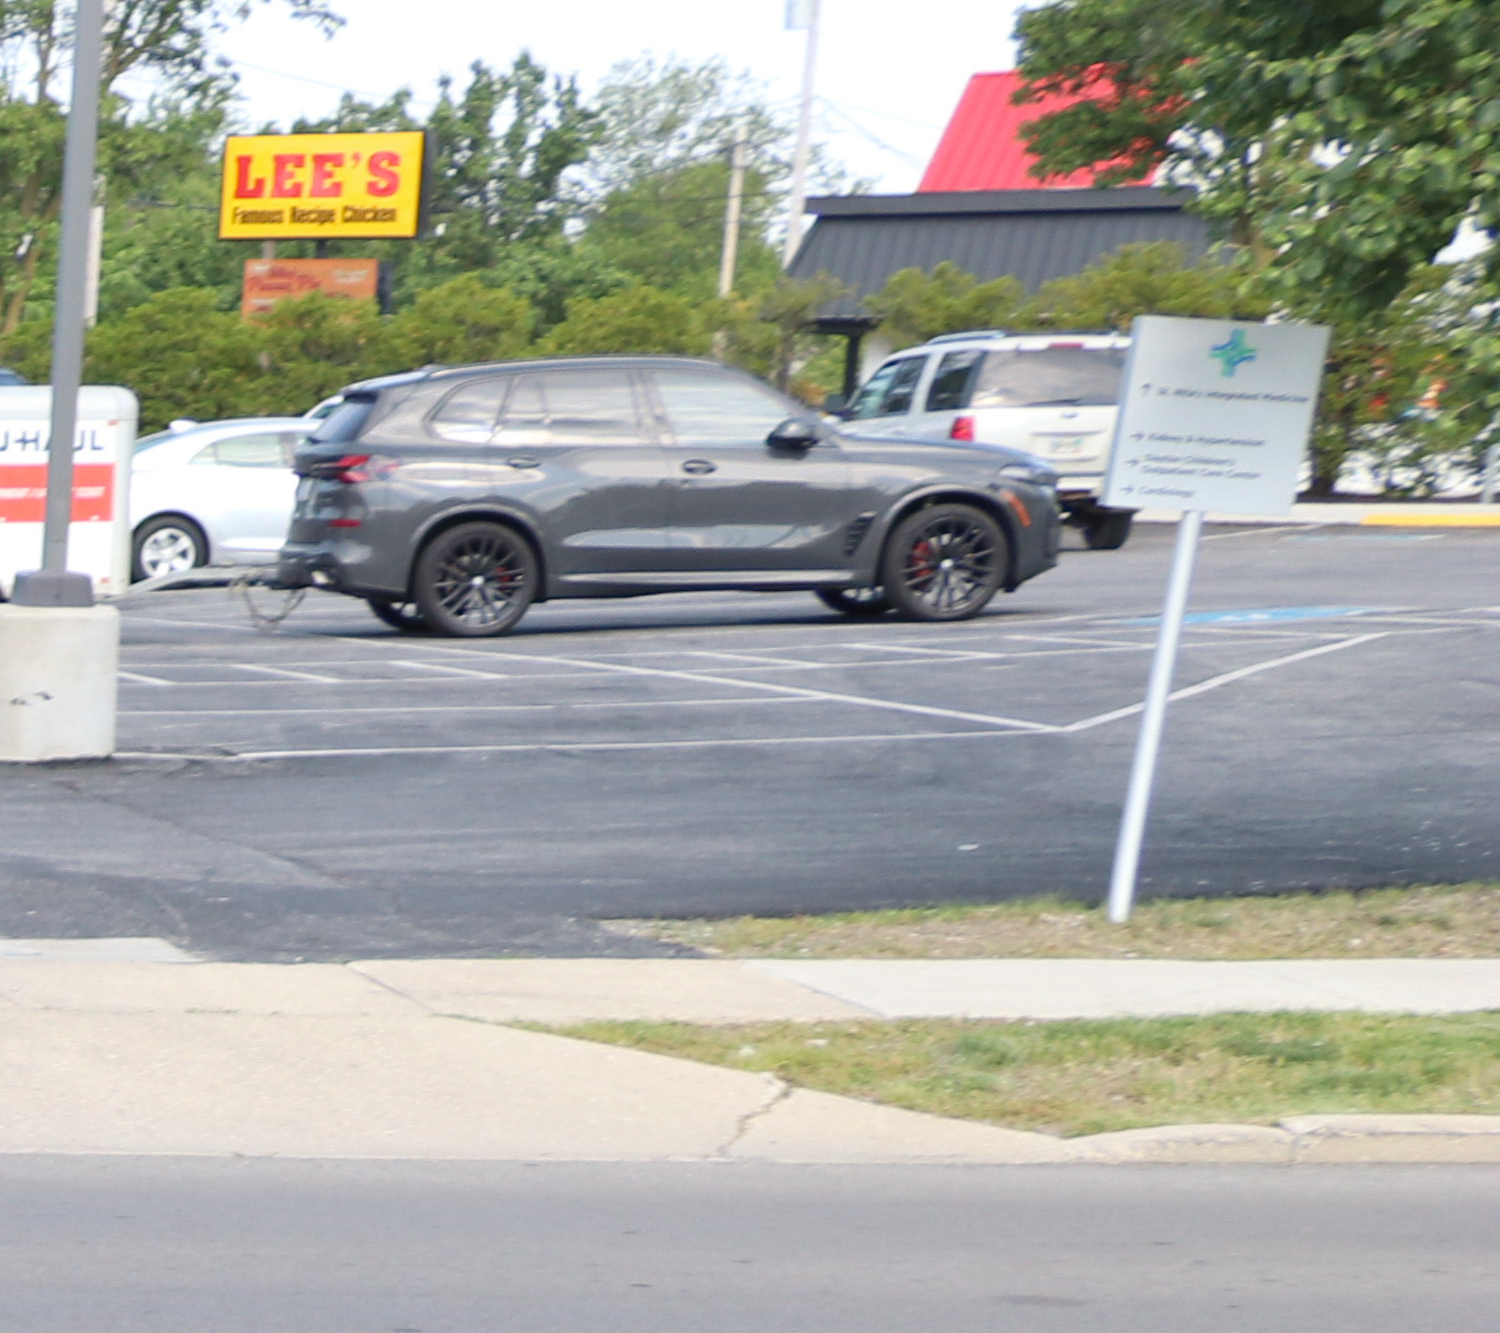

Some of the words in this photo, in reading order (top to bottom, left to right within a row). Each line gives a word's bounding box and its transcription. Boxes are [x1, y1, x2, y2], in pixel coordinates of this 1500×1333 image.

[233, 151, 401, 199] LEE'S
[232, 207, 284, 224] Famous
[289, 206, 336, 225] Recipe
[342, 205, 397, 223] Chicken
